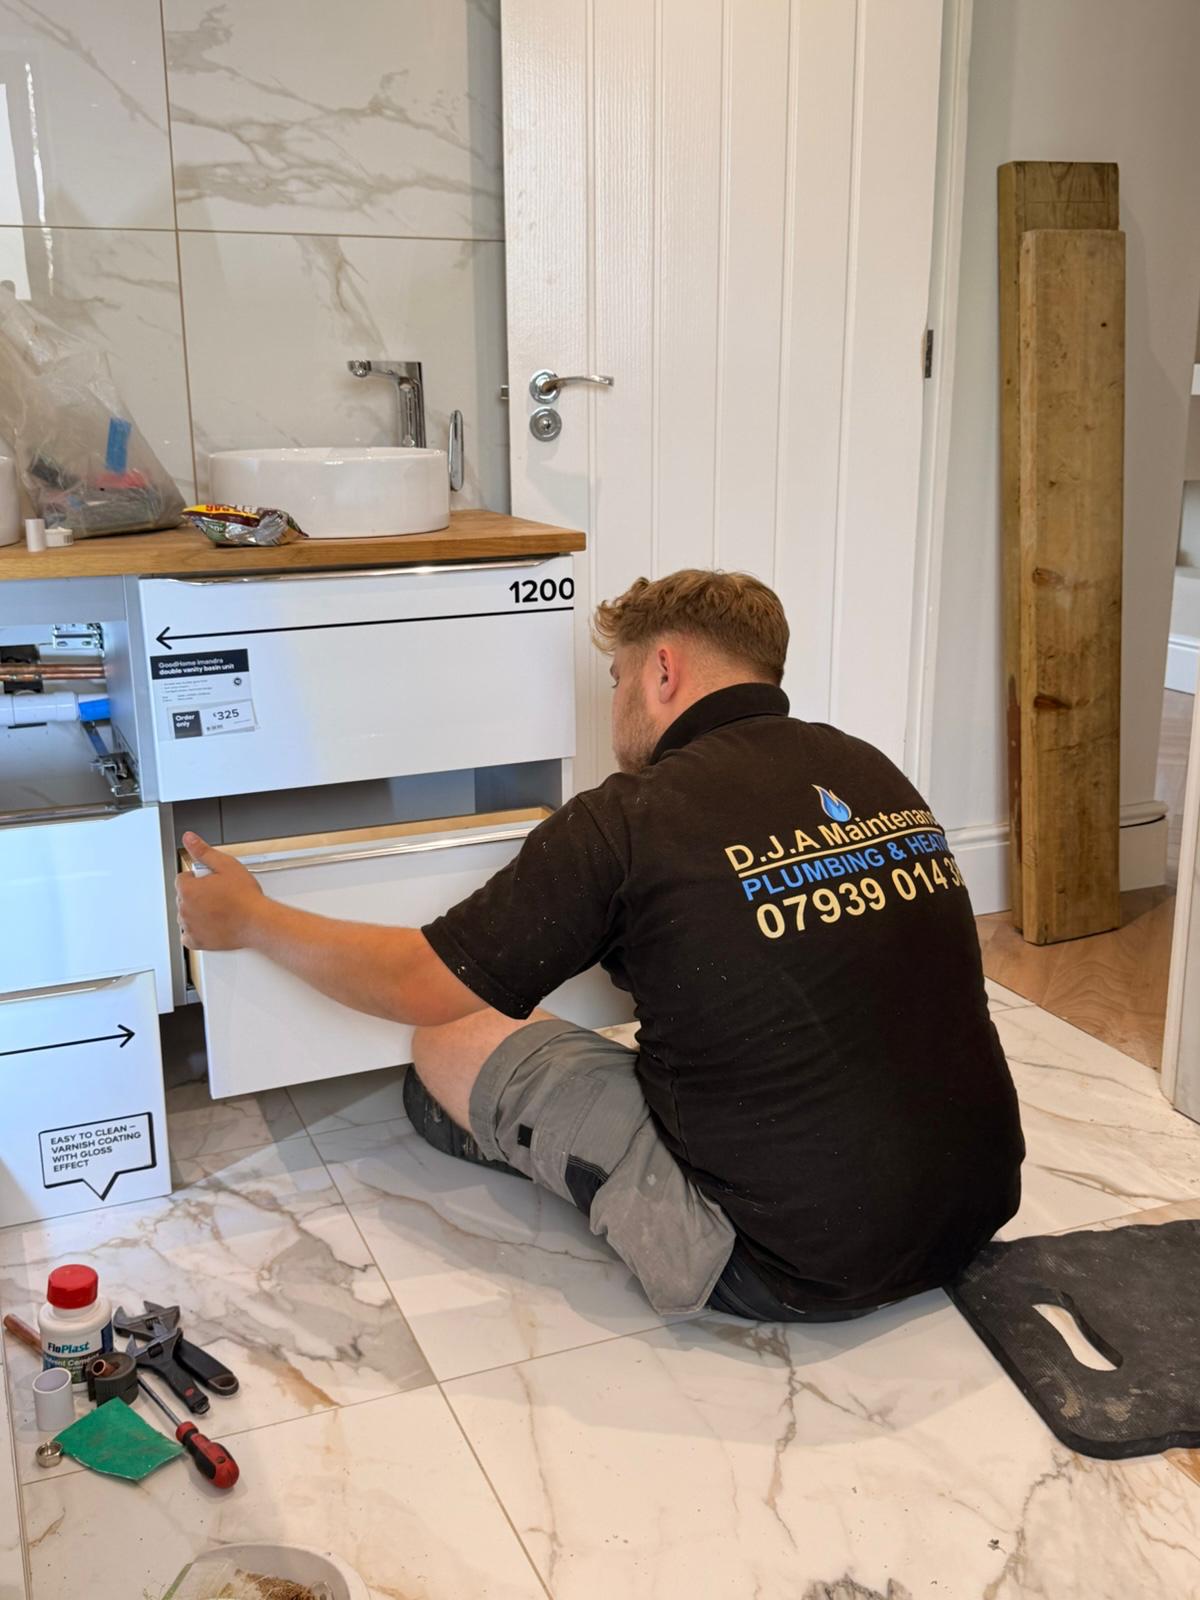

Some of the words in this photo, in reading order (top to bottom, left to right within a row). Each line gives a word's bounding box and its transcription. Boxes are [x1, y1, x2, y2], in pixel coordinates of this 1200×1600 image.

[509, 577, 575, 603] 1200
[159, 668, 183, 676] double
[175, 714, 195, 722] Order
[724, 829, 821, 872] D.J.A
[816, 808, 938, 847] Maintenan
[741, 847, 885, 902] PLUMBING
[886, 842, 908, 861] &
[756, 877, 886, 939] 07939
[50, 1134, 76, 1145] EASY
[79, 1131, 93, 1140] TO
[95, 1125, 128, 1137] CLEAN
[51, 1140, 96, 1154] VARNISH
[97, 1131, 141, 1145] COATING
[52, 1152, 78, 1163] WITH
[80, 1146, 113, 1159] GLOSS
[53, 1159, 90, 1172] EFFECT
[48, 1341, 90, 1354] FloPlast
